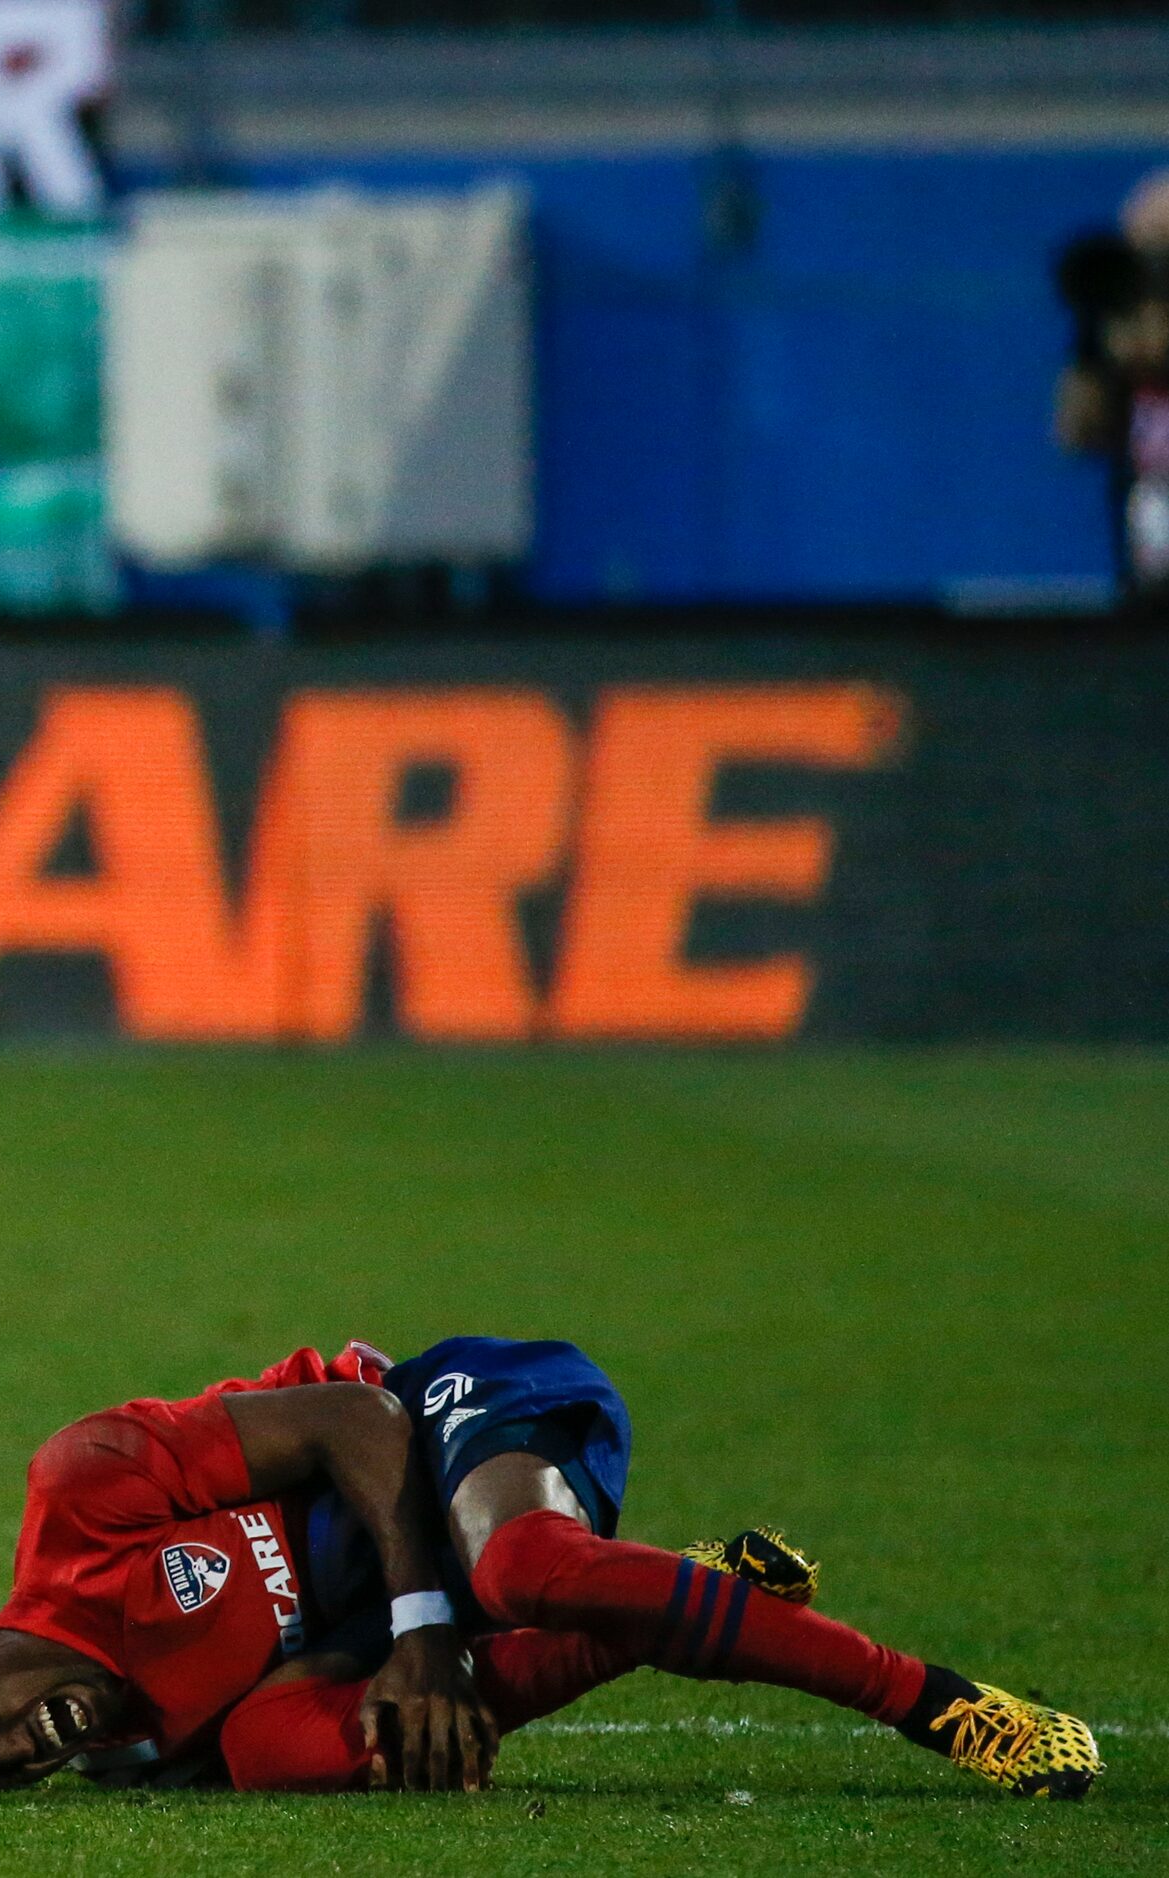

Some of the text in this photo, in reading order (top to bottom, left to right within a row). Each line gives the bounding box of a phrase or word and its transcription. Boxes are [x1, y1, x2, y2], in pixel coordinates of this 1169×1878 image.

[165, 1550, 189, 1592] DALLAS
[237, 1511, 306, 1653] OCARE
[180, 1591, 199, 1607] FC
